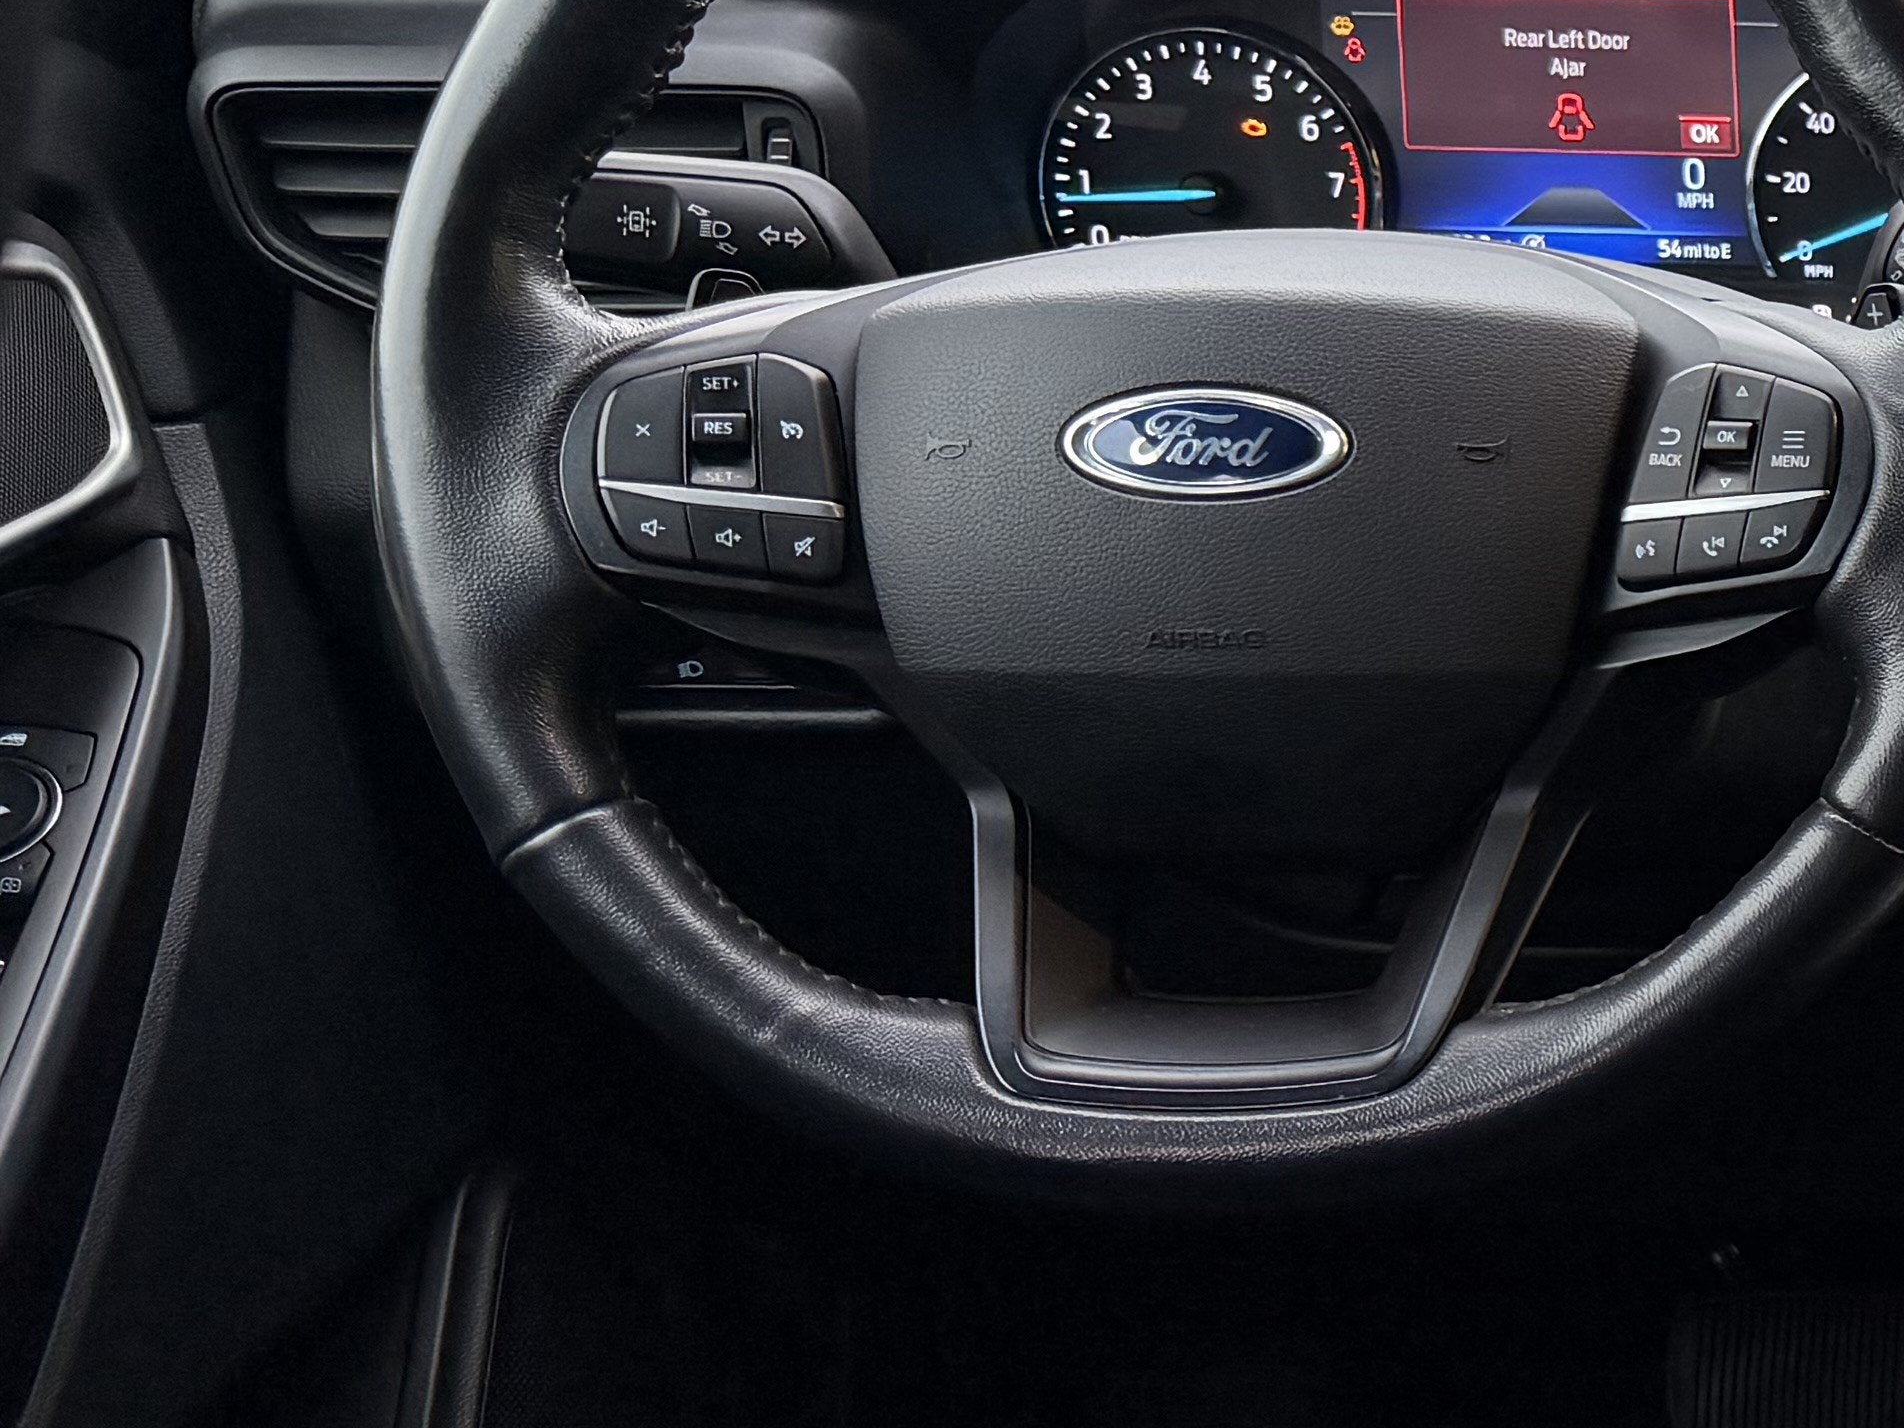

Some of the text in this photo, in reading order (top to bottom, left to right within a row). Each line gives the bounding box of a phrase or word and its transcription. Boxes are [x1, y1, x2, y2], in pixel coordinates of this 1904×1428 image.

[1504, 28, 1631, 51] Rear Left Door
[1194, 61, 1213, 86] 4
[1550, 58, 1587, 80] Ajar
[1137, 74, 1274, 103] 3 5
[1095, 113, 1320, 143] 2 6
[1805, 114, 1836, 135] 40
[1689, 126, 1720, 145] OK
[1078, 170, 1346, 199] 1 7
[1681, 157, 1706, 191] 0
[1783, 172, 1811, 194] 20
[1677, 193, 1715, 210] MPH
[1657, 239, 1682, 259] 54
[1704, 243, 1720, 260] to
[1721, 243, 1732, 260] E
[1804, 265, 1834, 279] MPH
[704, 422, 734, 436] RES
[1129, 408, 1275, 469] Ford
[1717, 430, 1737, 444] OK
[1649, 453, 1684, 468] BACK
[1771, 455, 1811, 469] MENU
[1145, 630, 1265, 650] AIRBAG
